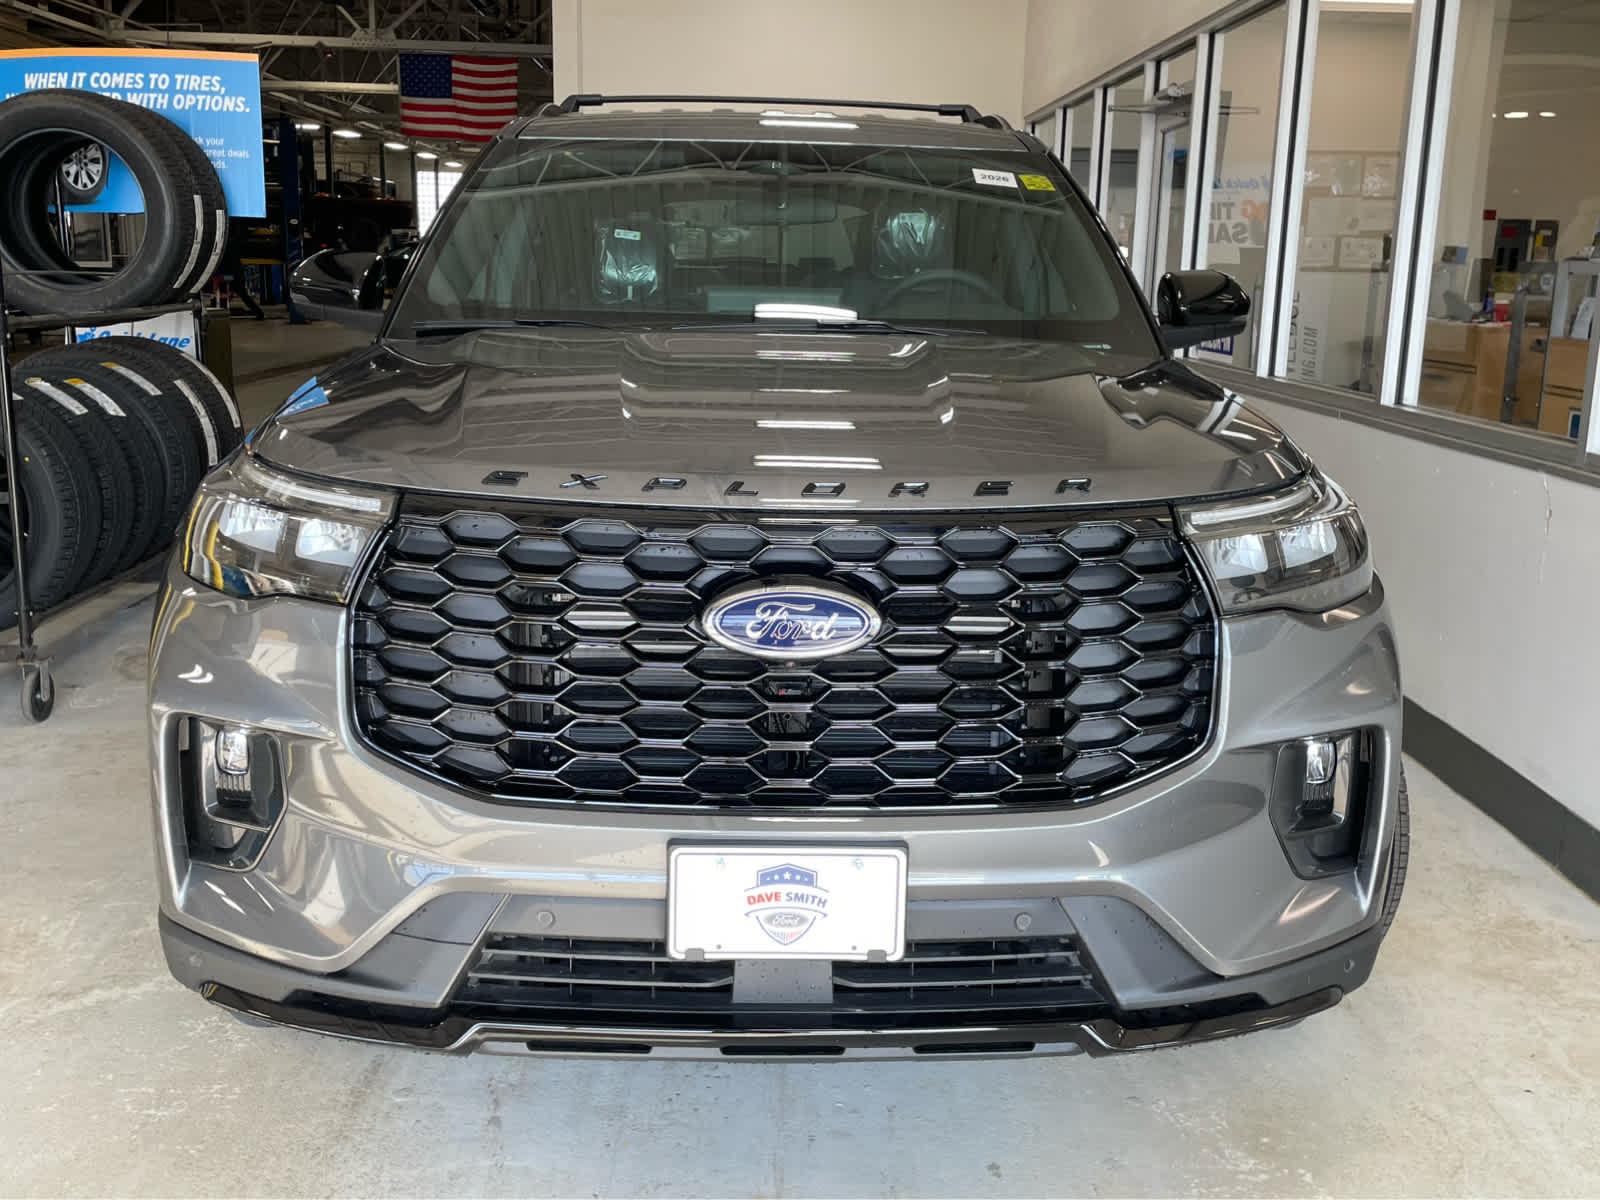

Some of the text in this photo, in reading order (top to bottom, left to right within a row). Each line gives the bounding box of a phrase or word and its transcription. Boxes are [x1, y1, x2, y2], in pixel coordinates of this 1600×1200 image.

[24, 72, 226, 95] WHEN IT COMES TO TIRES,
[127, 93, 169, 109] WITH
[172, 94, 251, 113] OPTIONS.
[205, 137, 225, 147] your
[979, 173, 1009, 183] 2026
[481, 470, 1092, 497] EXPLORER
[746, 601, 838, 641] Ford
[747, 891, 828, 909] DAVE SMITH
